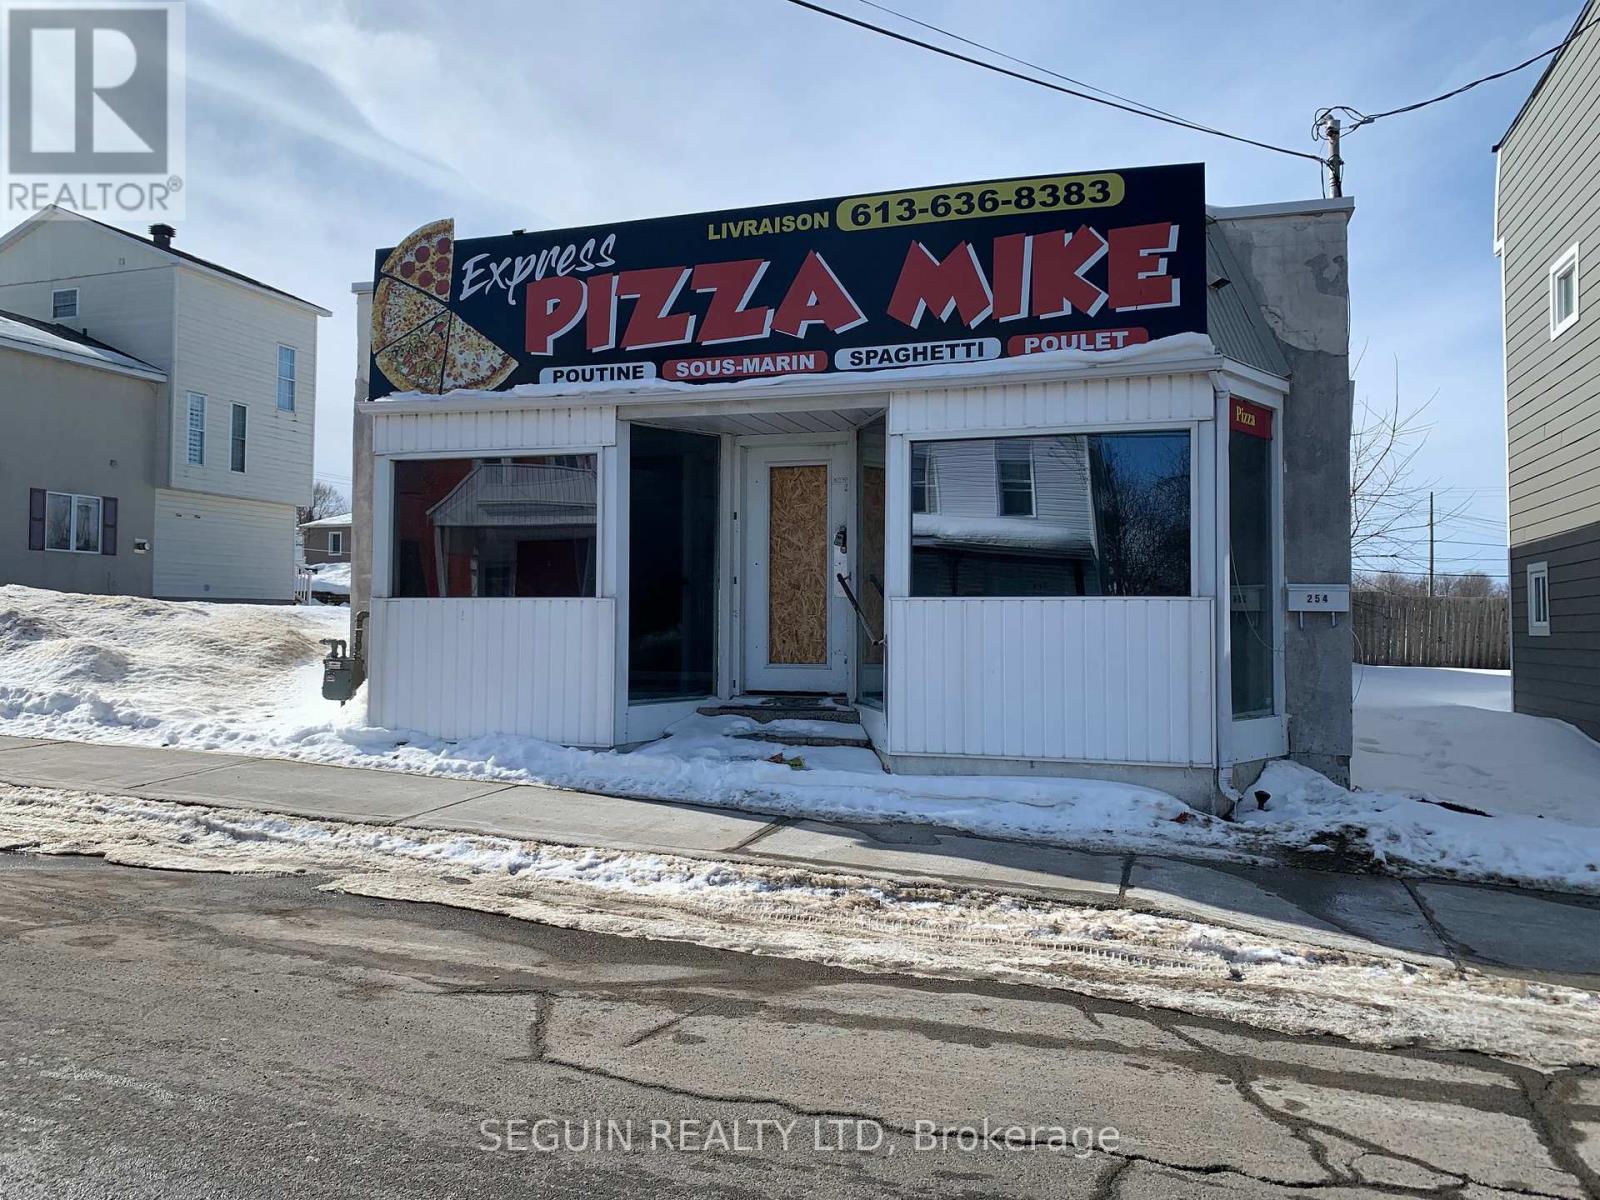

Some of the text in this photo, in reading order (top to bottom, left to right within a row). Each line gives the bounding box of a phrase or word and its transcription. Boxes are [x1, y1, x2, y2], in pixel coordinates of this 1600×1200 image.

[707, 180, 1111, 241] LIVRAISON 613-636-8383
[460, 233, 617, 305] Express
[524, 222, 1181, 356] PIZZA MIKE
[849, 341, 985, 367] SPAGHETTI
[1024, 330, 1130, 353] POULET
[552, 365, 645, 383] POUTINE
[675, 352, 815, 378] SOUS-MARIN
[1236, 405, 1256, 426] Pizza
[1307, 594, 1329, 603] 254
